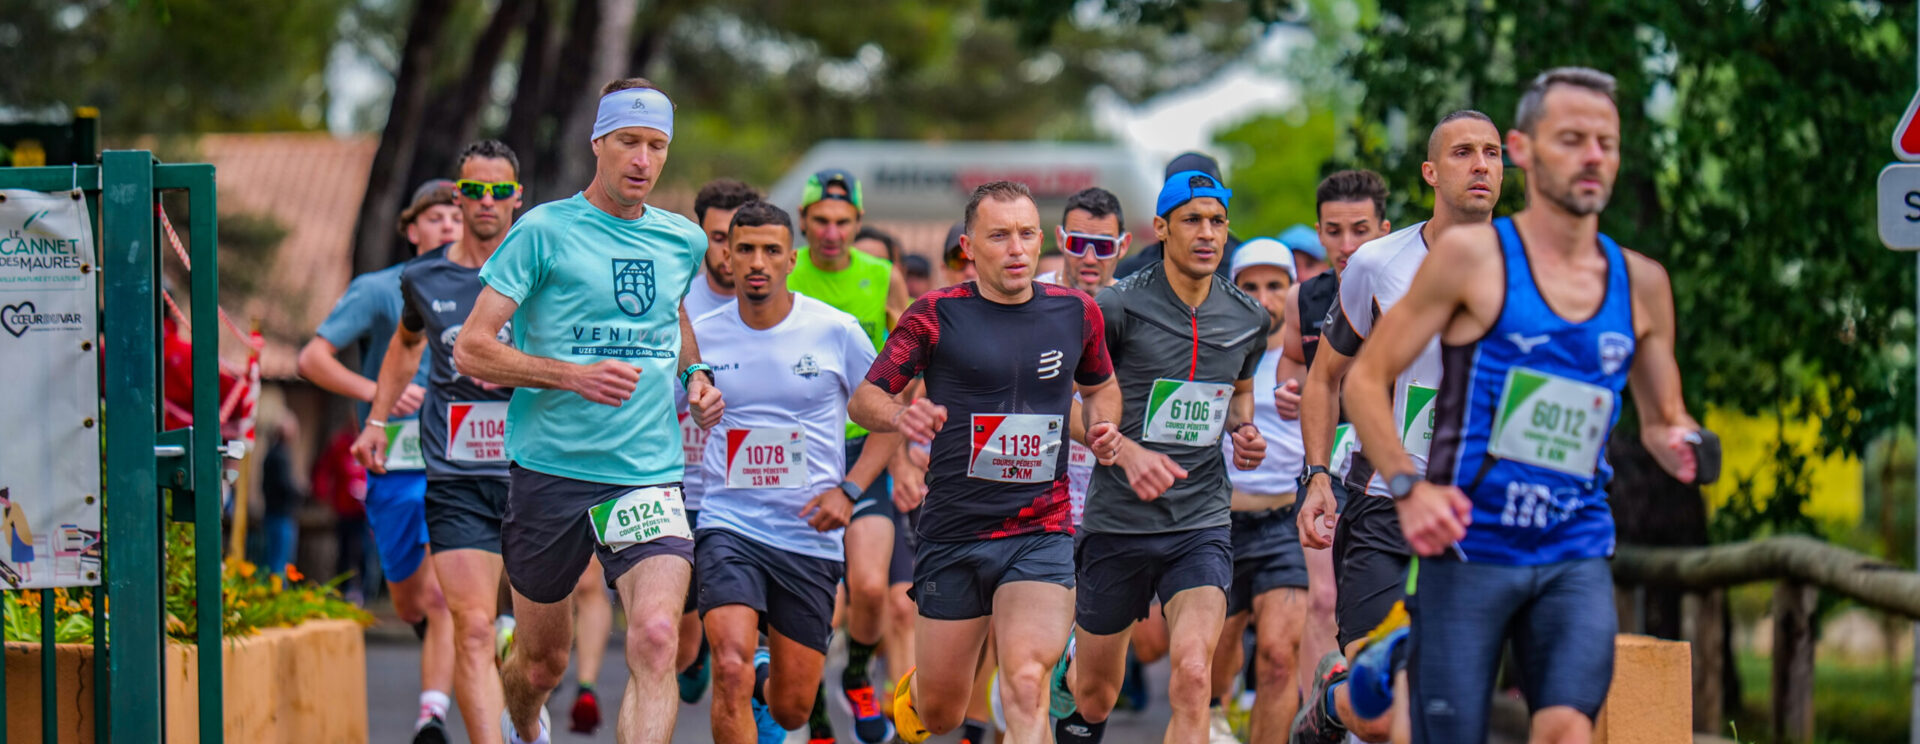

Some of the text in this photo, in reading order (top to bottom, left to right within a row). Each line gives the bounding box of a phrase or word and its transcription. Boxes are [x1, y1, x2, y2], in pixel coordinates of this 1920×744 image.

[9, 229, 20, 240] LE
[0, 238, 80, 255] CANNET
[20, 256, 80, 272] MAURES
[603, 348, 622, 356] PONT
[1170, 399, 1210, 421] 6106
[1165, 420, 1186, 429] COURSE
[1532, 400, 1586, 438] 6012
[469, 419, 504, 439] 1104
[1176, 430, 1198, 442] 6 KM
[998, 434, 1040, 457] 1139
[745, 444, 785, 465] 1078
[1072, 453, 1086, 462] KM
[752, 475, 780, 486] 13 KM
[1015, 468, 1032, 480] KM
[616, 500, 664, 527] 6124
[619, 524, 641, 537] COURSE
[634, 525, 661, 541] 6 KM
